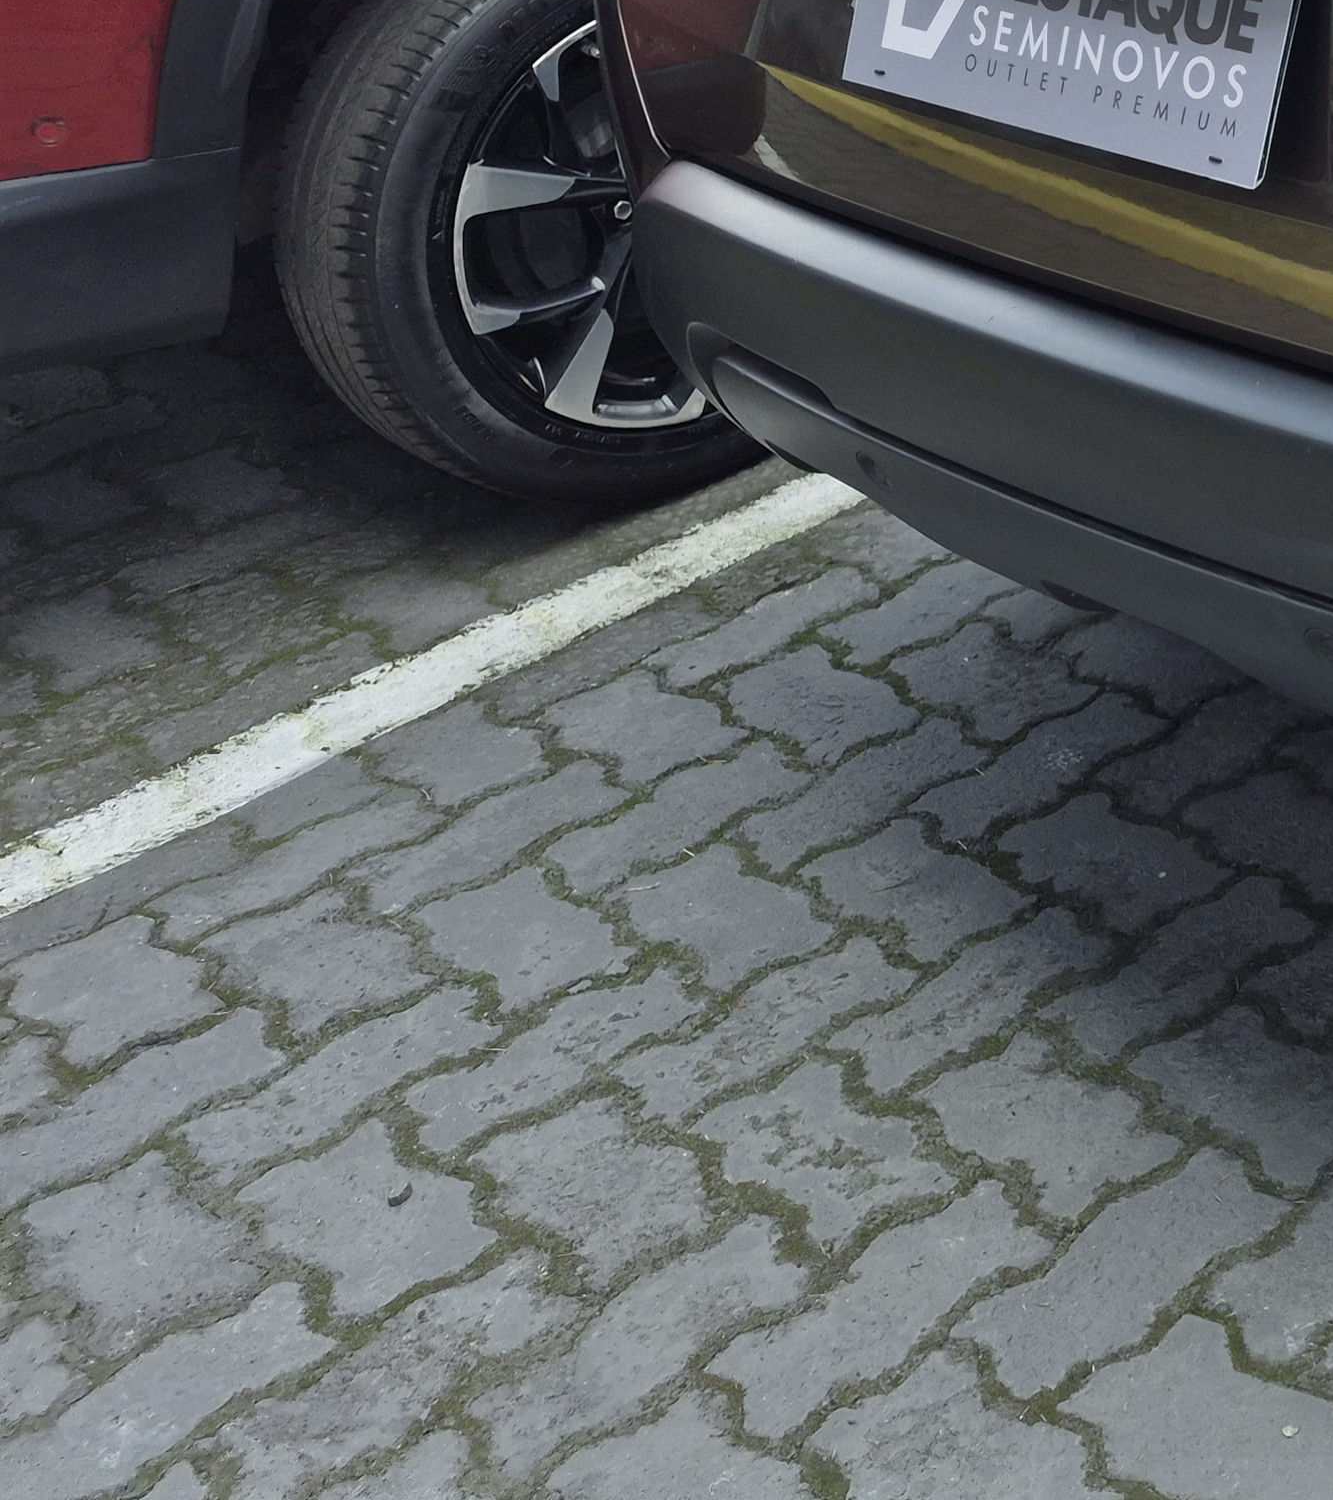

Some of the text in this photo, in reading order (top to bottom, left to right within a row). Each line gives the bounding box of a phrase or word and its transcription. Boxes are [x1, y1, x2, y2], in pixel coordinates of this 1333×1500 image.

[963, 52, 1239, 138] OUTLET PREMIUM
[968, 4, 1248, 108] SEMINOVOS
